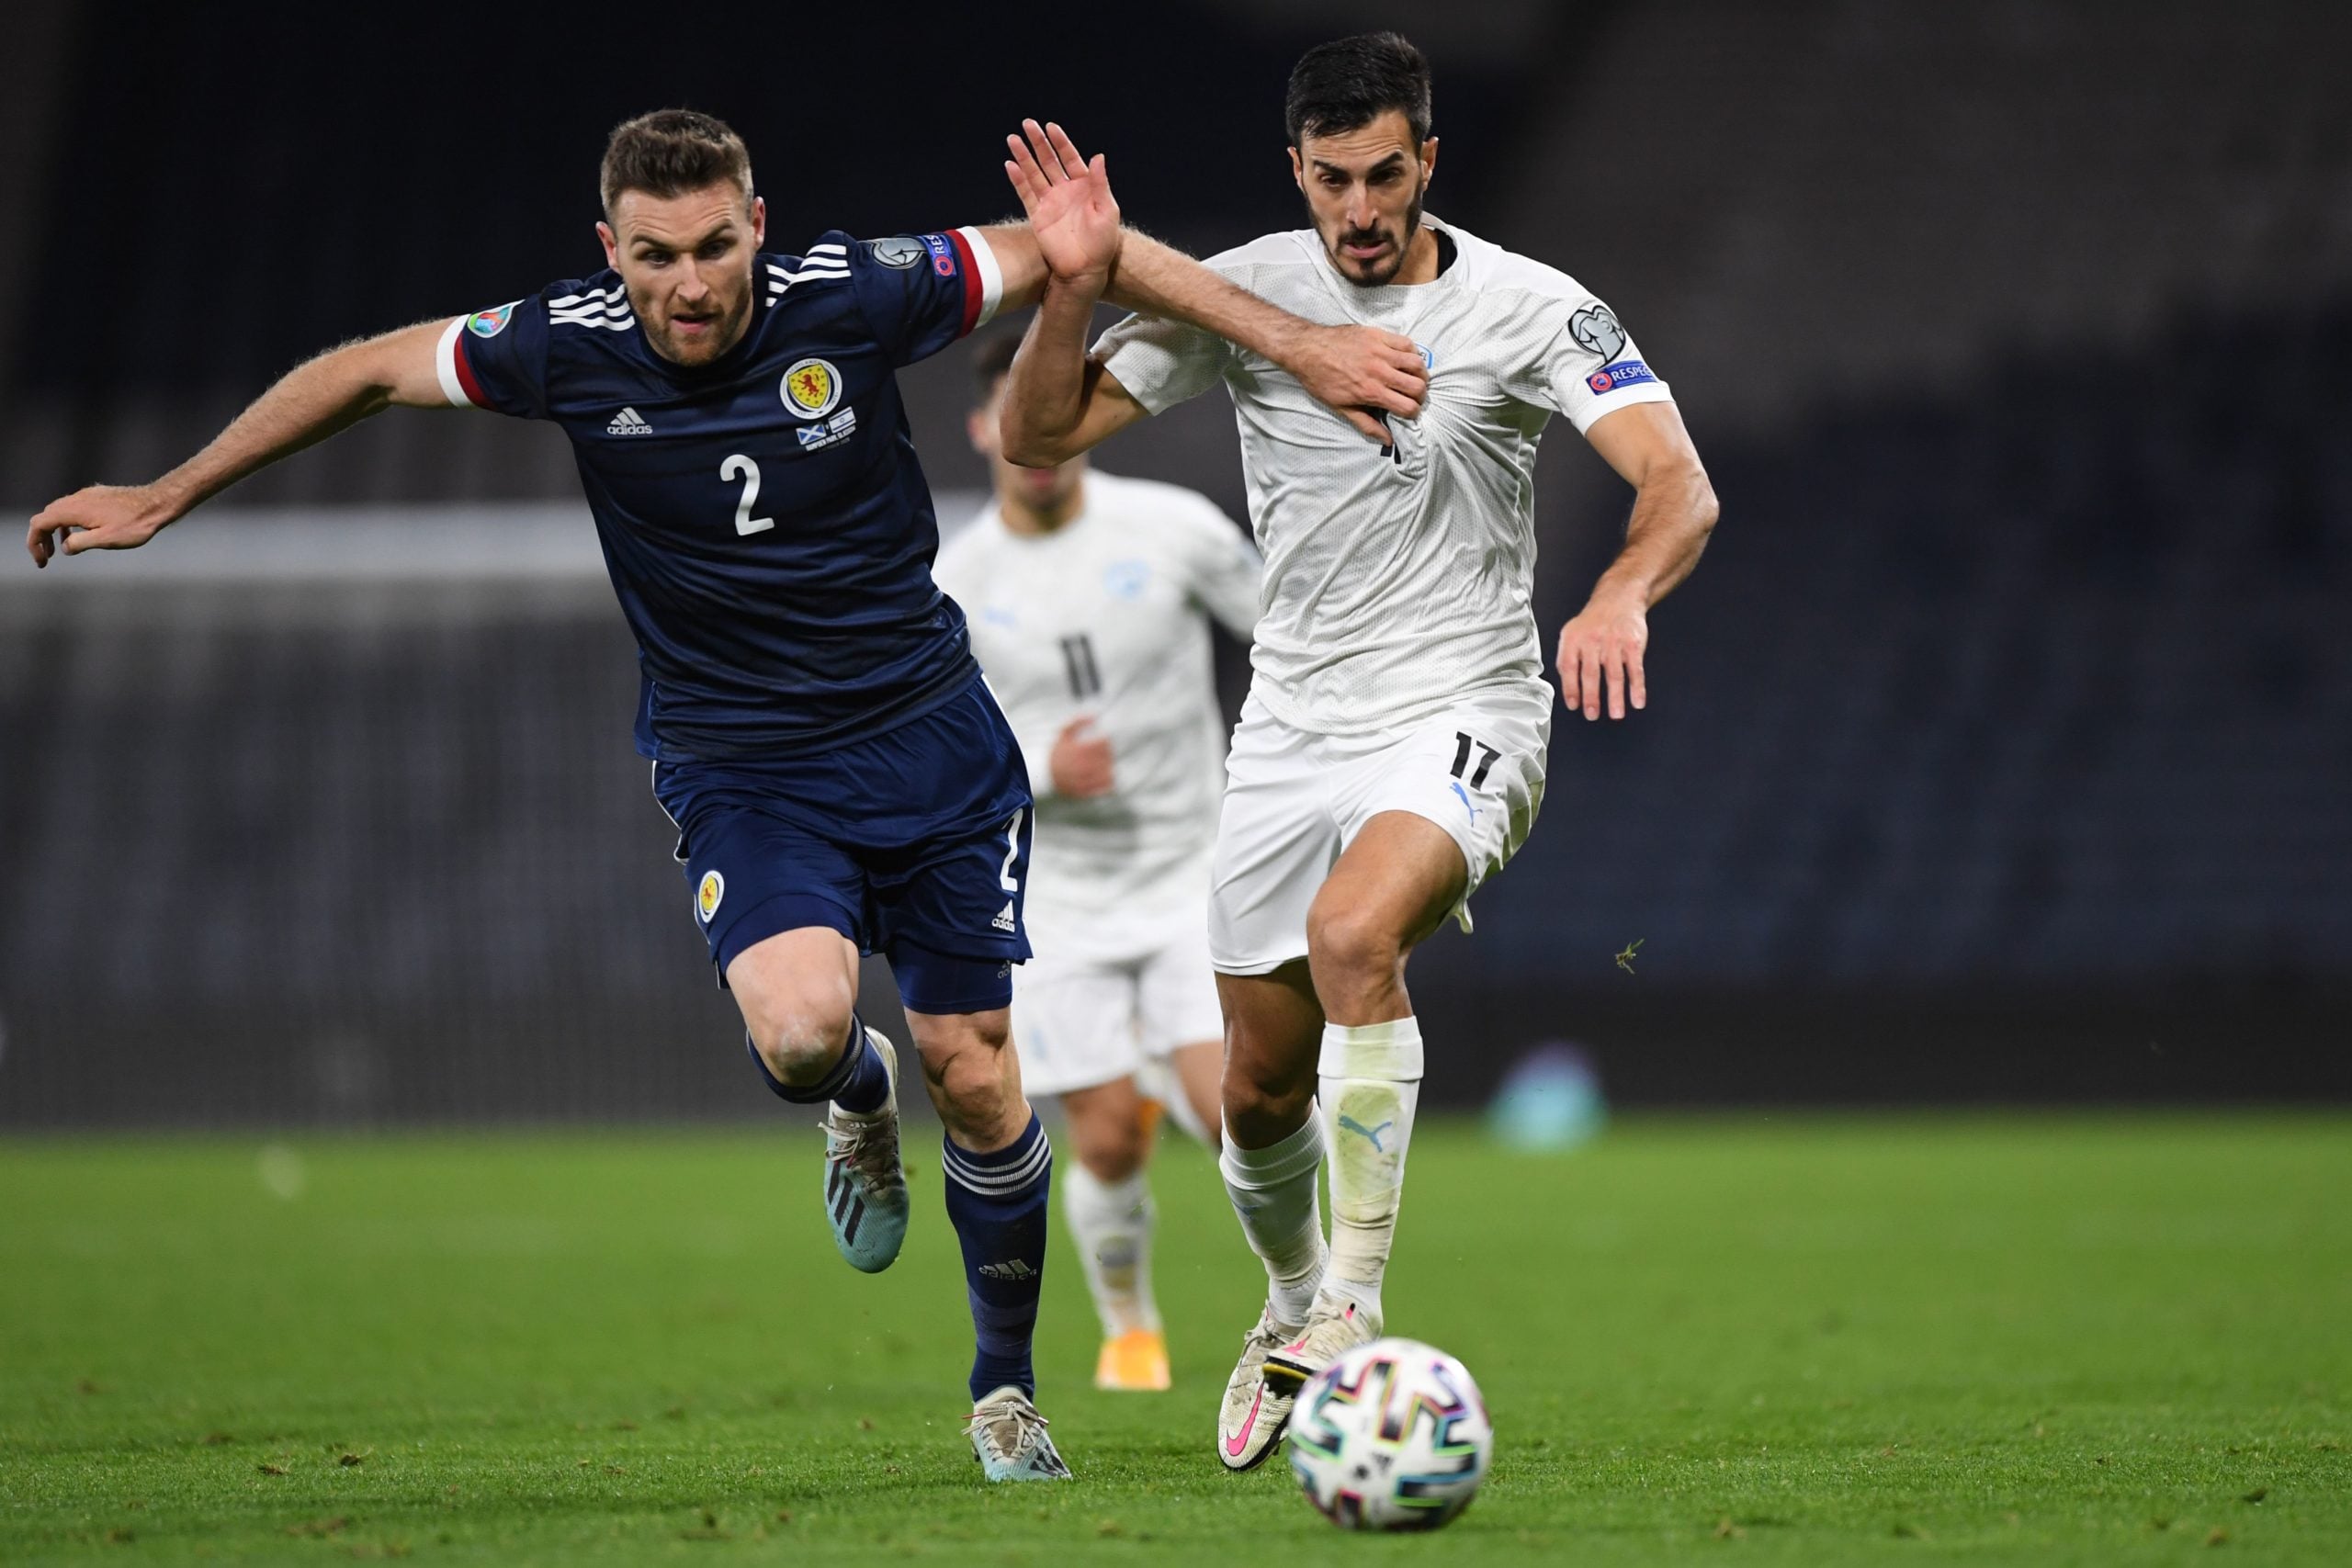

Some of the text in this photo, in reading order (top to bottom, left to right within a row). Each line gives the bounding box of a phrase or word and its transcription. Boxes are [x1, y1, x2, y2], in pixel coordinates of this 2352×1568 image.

[606, 424, 653, 435] adidas
[719, 453, 775, 536] 2
[1060, 635, 1101, 696] 11
[1449, 730, 1502, 792] 17
[1000, 807, 1023, 893] 2
[991, 918, 1015, 933] adida
